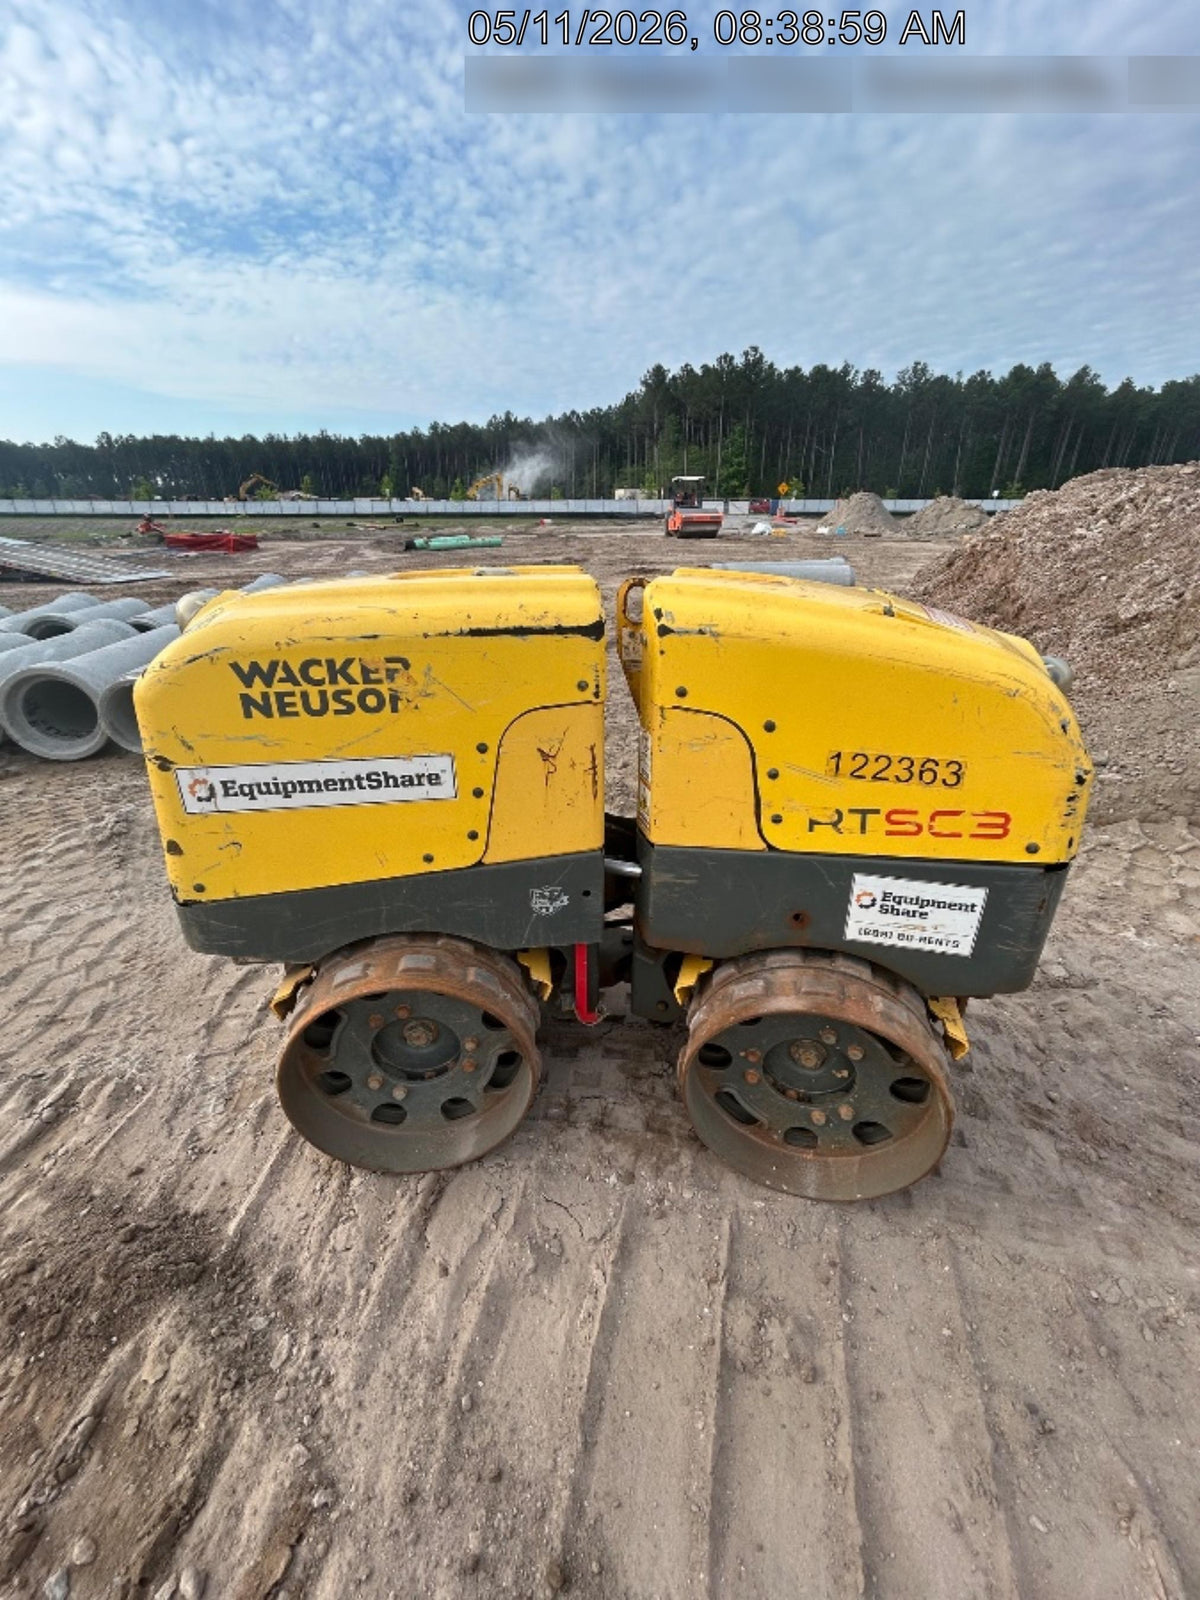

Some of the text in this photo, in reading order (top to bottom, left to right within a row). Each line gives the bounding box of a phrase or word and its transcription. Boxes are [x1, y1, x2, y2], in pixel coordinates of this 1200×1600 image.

[830, 751, 963, 787] 122363
[220, 770, 442, 800] EquipmentShare
[878, 904, 929, 920] Share
[880, 891, 978, 913] Equipment
